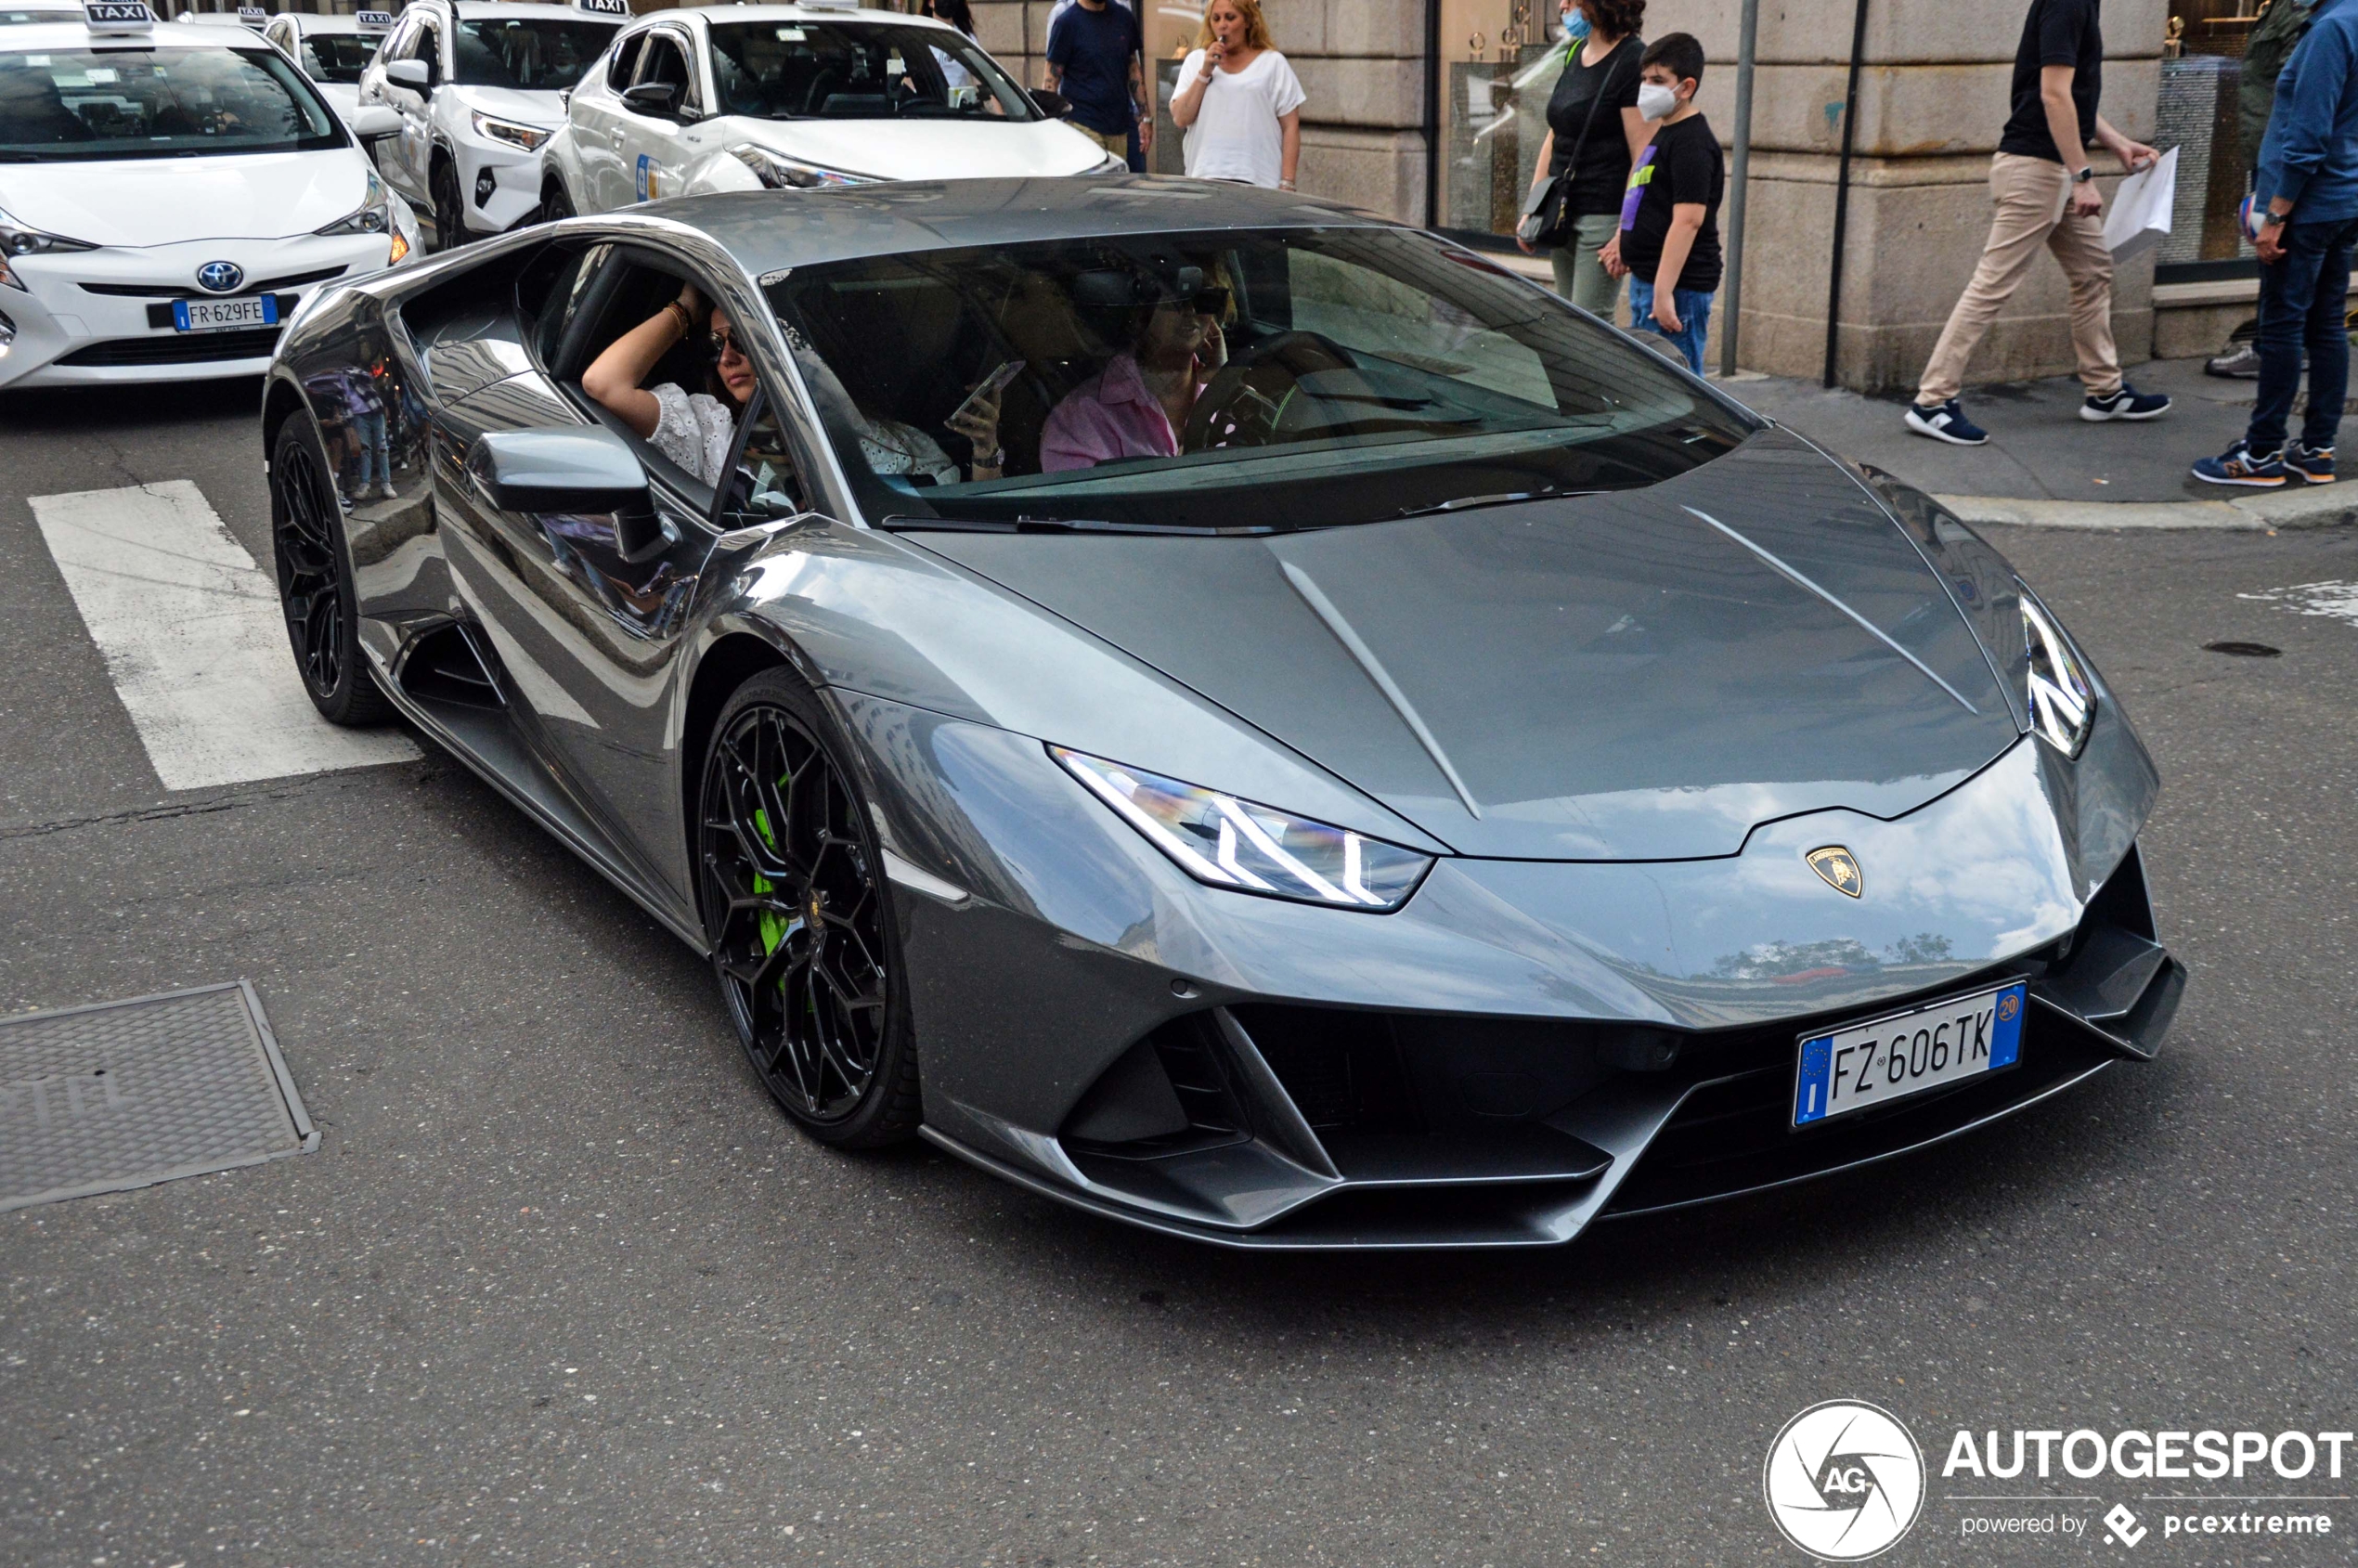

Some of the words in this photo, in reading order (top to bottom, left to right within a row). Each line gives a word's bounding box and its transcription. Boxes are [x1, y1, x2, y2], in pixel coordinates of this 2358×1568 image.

[90, 6, 144, 18] TAXI
[240, 7, 264, 16] TAXI
[359, 13, 389, 23] TAXI
[2001, 998, 2016, 1017] 20
